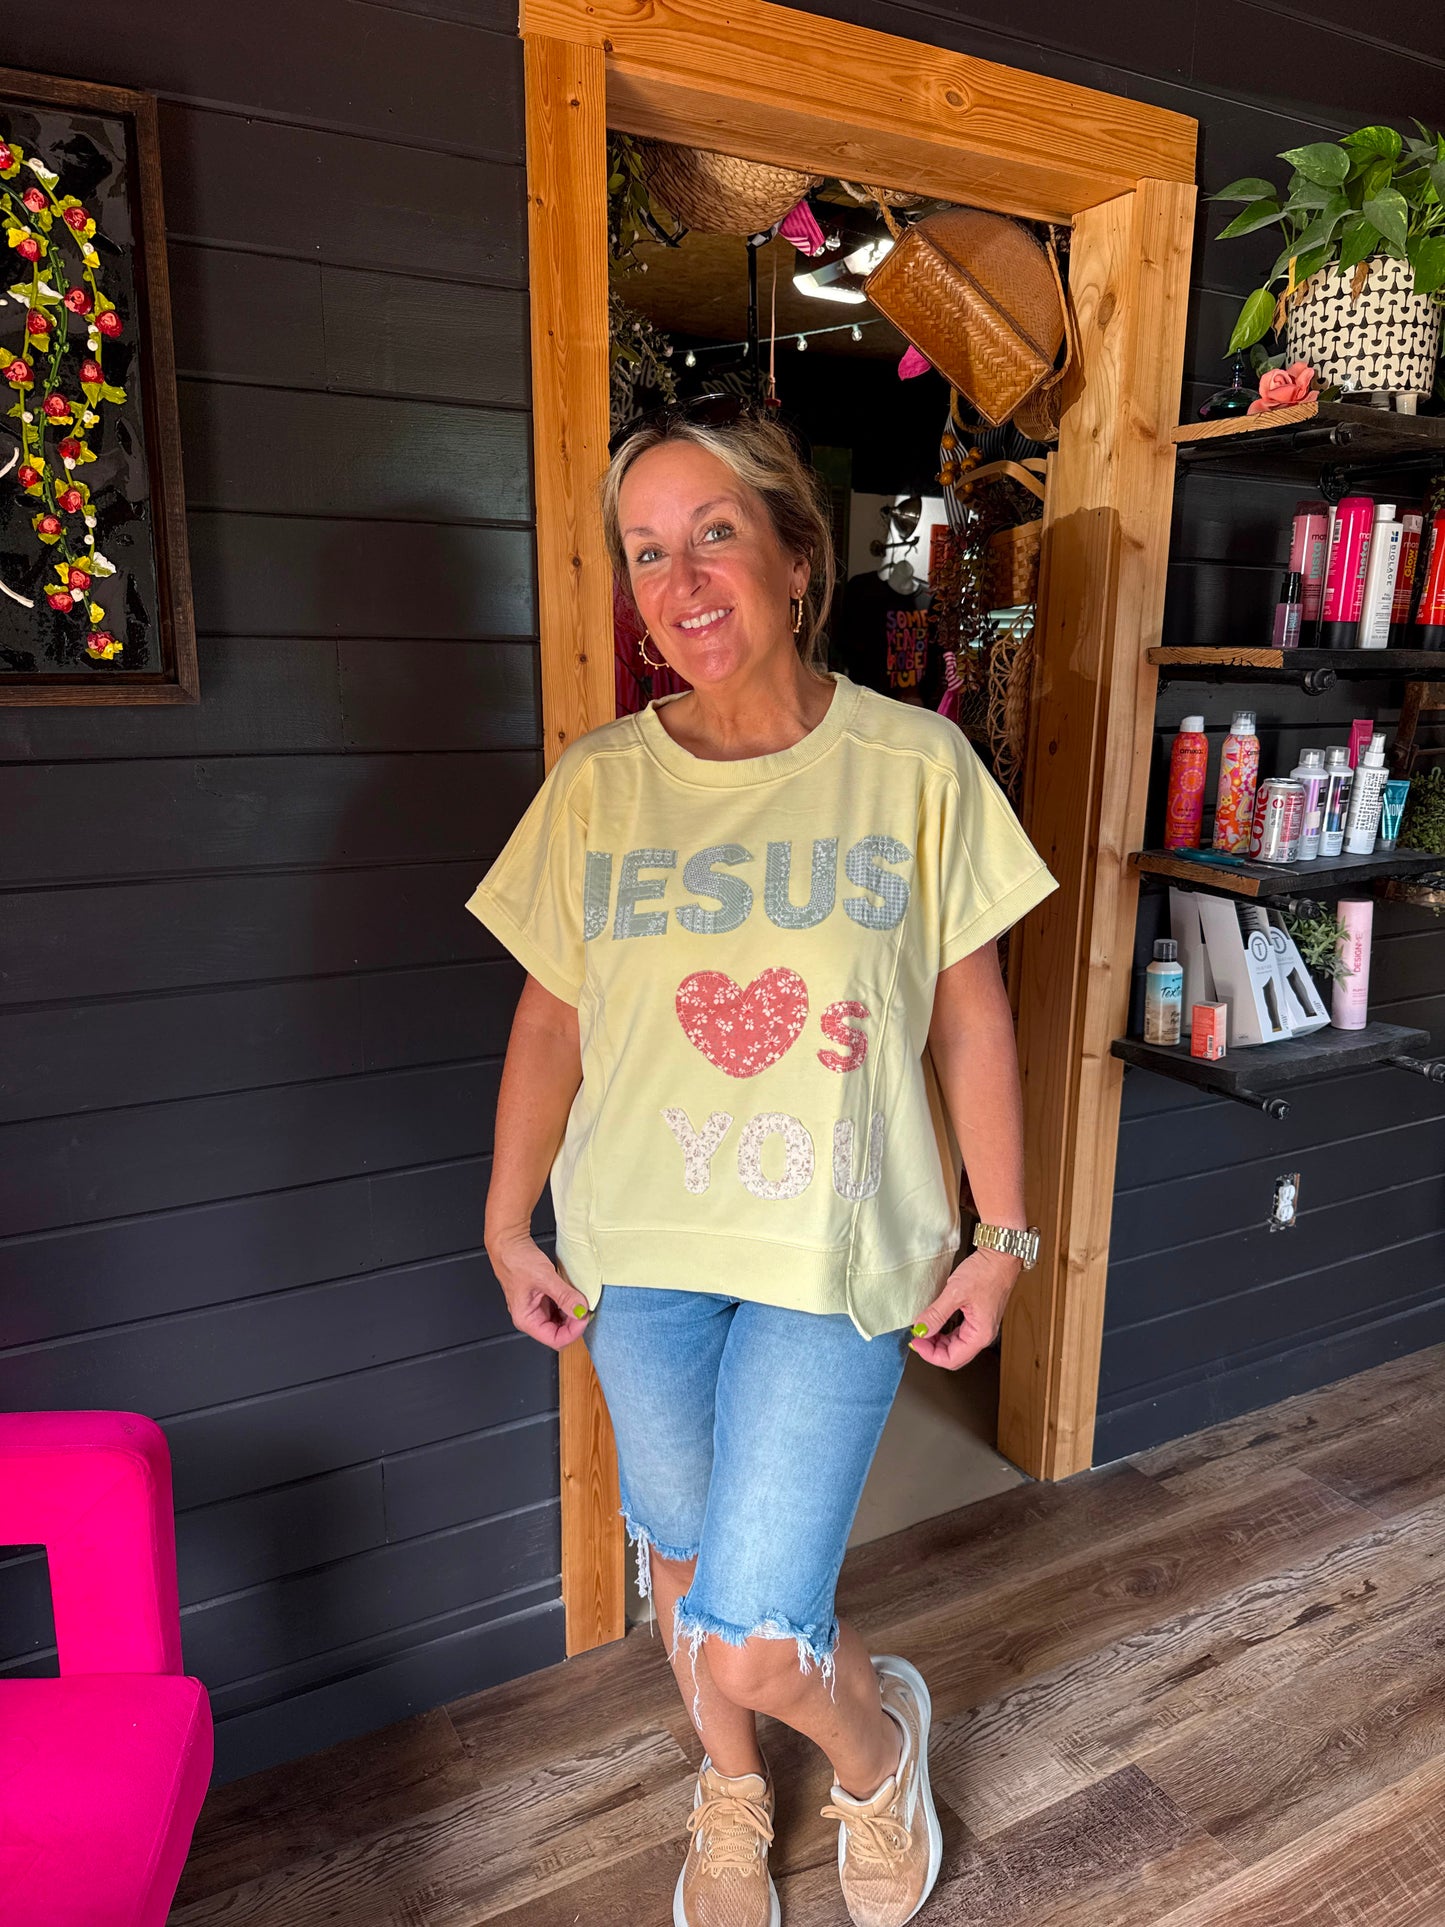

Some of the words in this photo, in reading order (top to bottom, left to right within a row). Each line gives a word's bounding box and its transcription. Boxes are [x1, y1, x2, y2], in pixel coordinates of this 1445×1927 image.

[1386, 544, 1397, 586] BIOLAGE
[1404, 549, 1415, 577] Glow
[886, 609, 929, 630] SOME
[583, 834, 913, 942] JESUS
[816, 1000, 870, 1074] S
[661, 1107, 885, 1201] YOU
